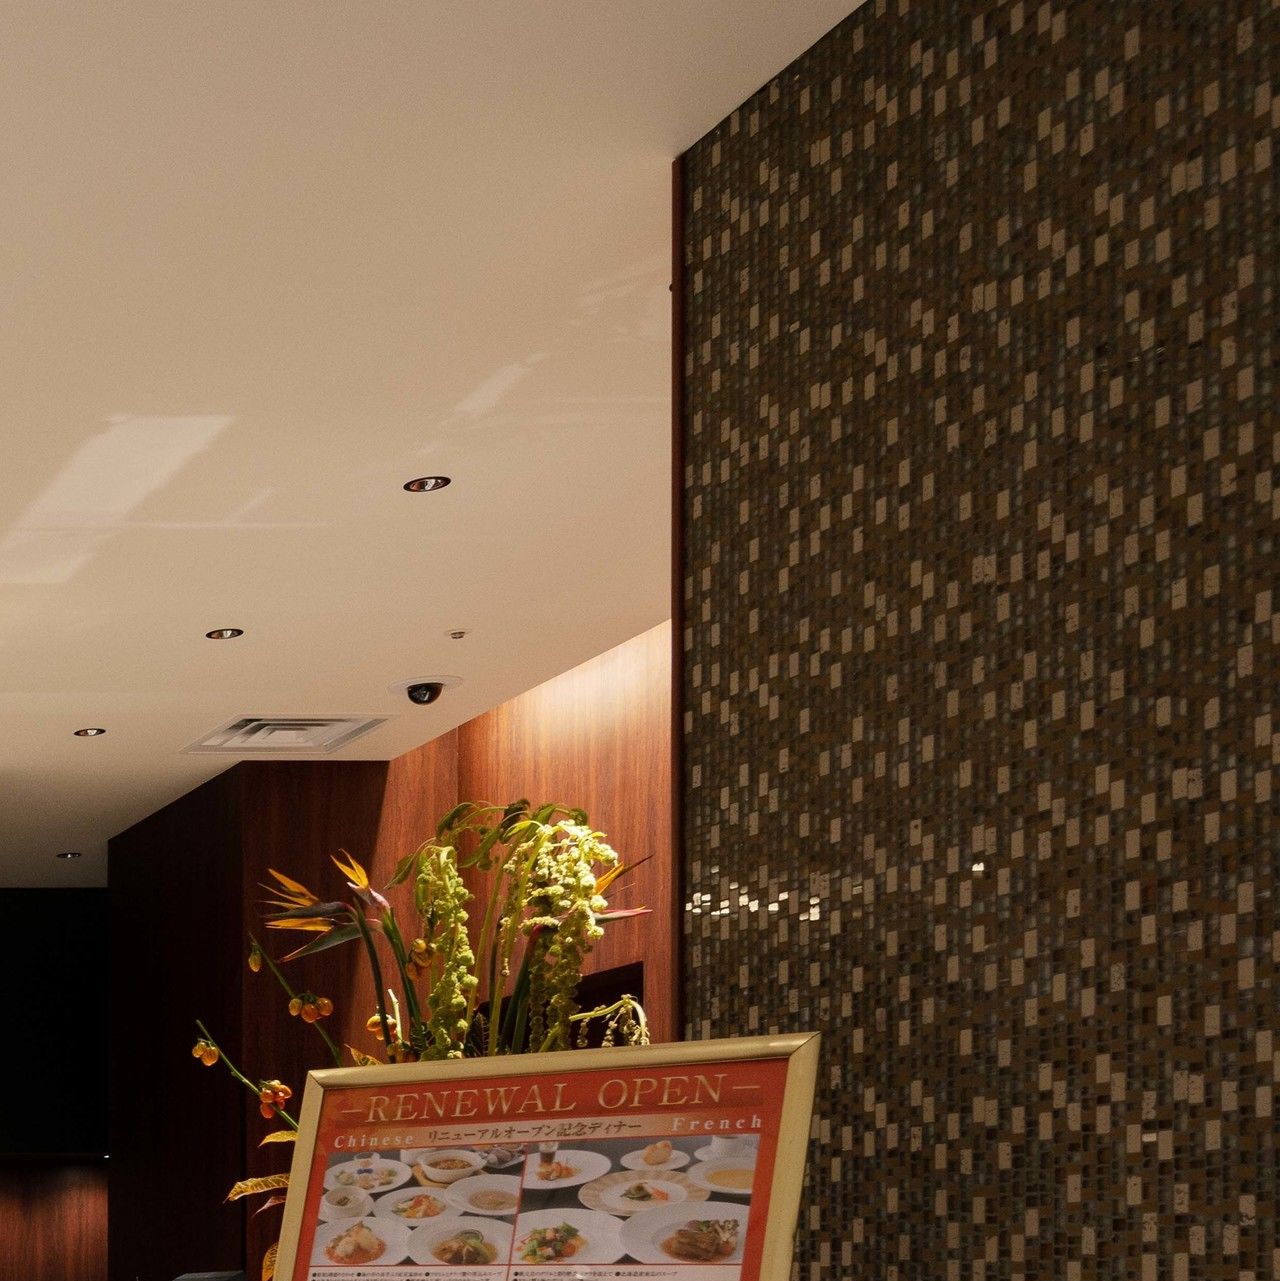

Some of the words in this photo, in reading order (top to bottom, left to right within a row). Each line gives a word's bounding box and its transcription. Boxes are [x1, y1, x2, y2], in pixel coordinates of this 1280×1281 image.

[364, 1083, 578, 1124] RENEWAL
[597, 1073, 729, 1110] OPEN
[427, 1121, 643, 1142] リニューアルオープン記念ディナー
[670, 1114, 762, 1132] French
[333, 1133, 415, 1149] Chinese
